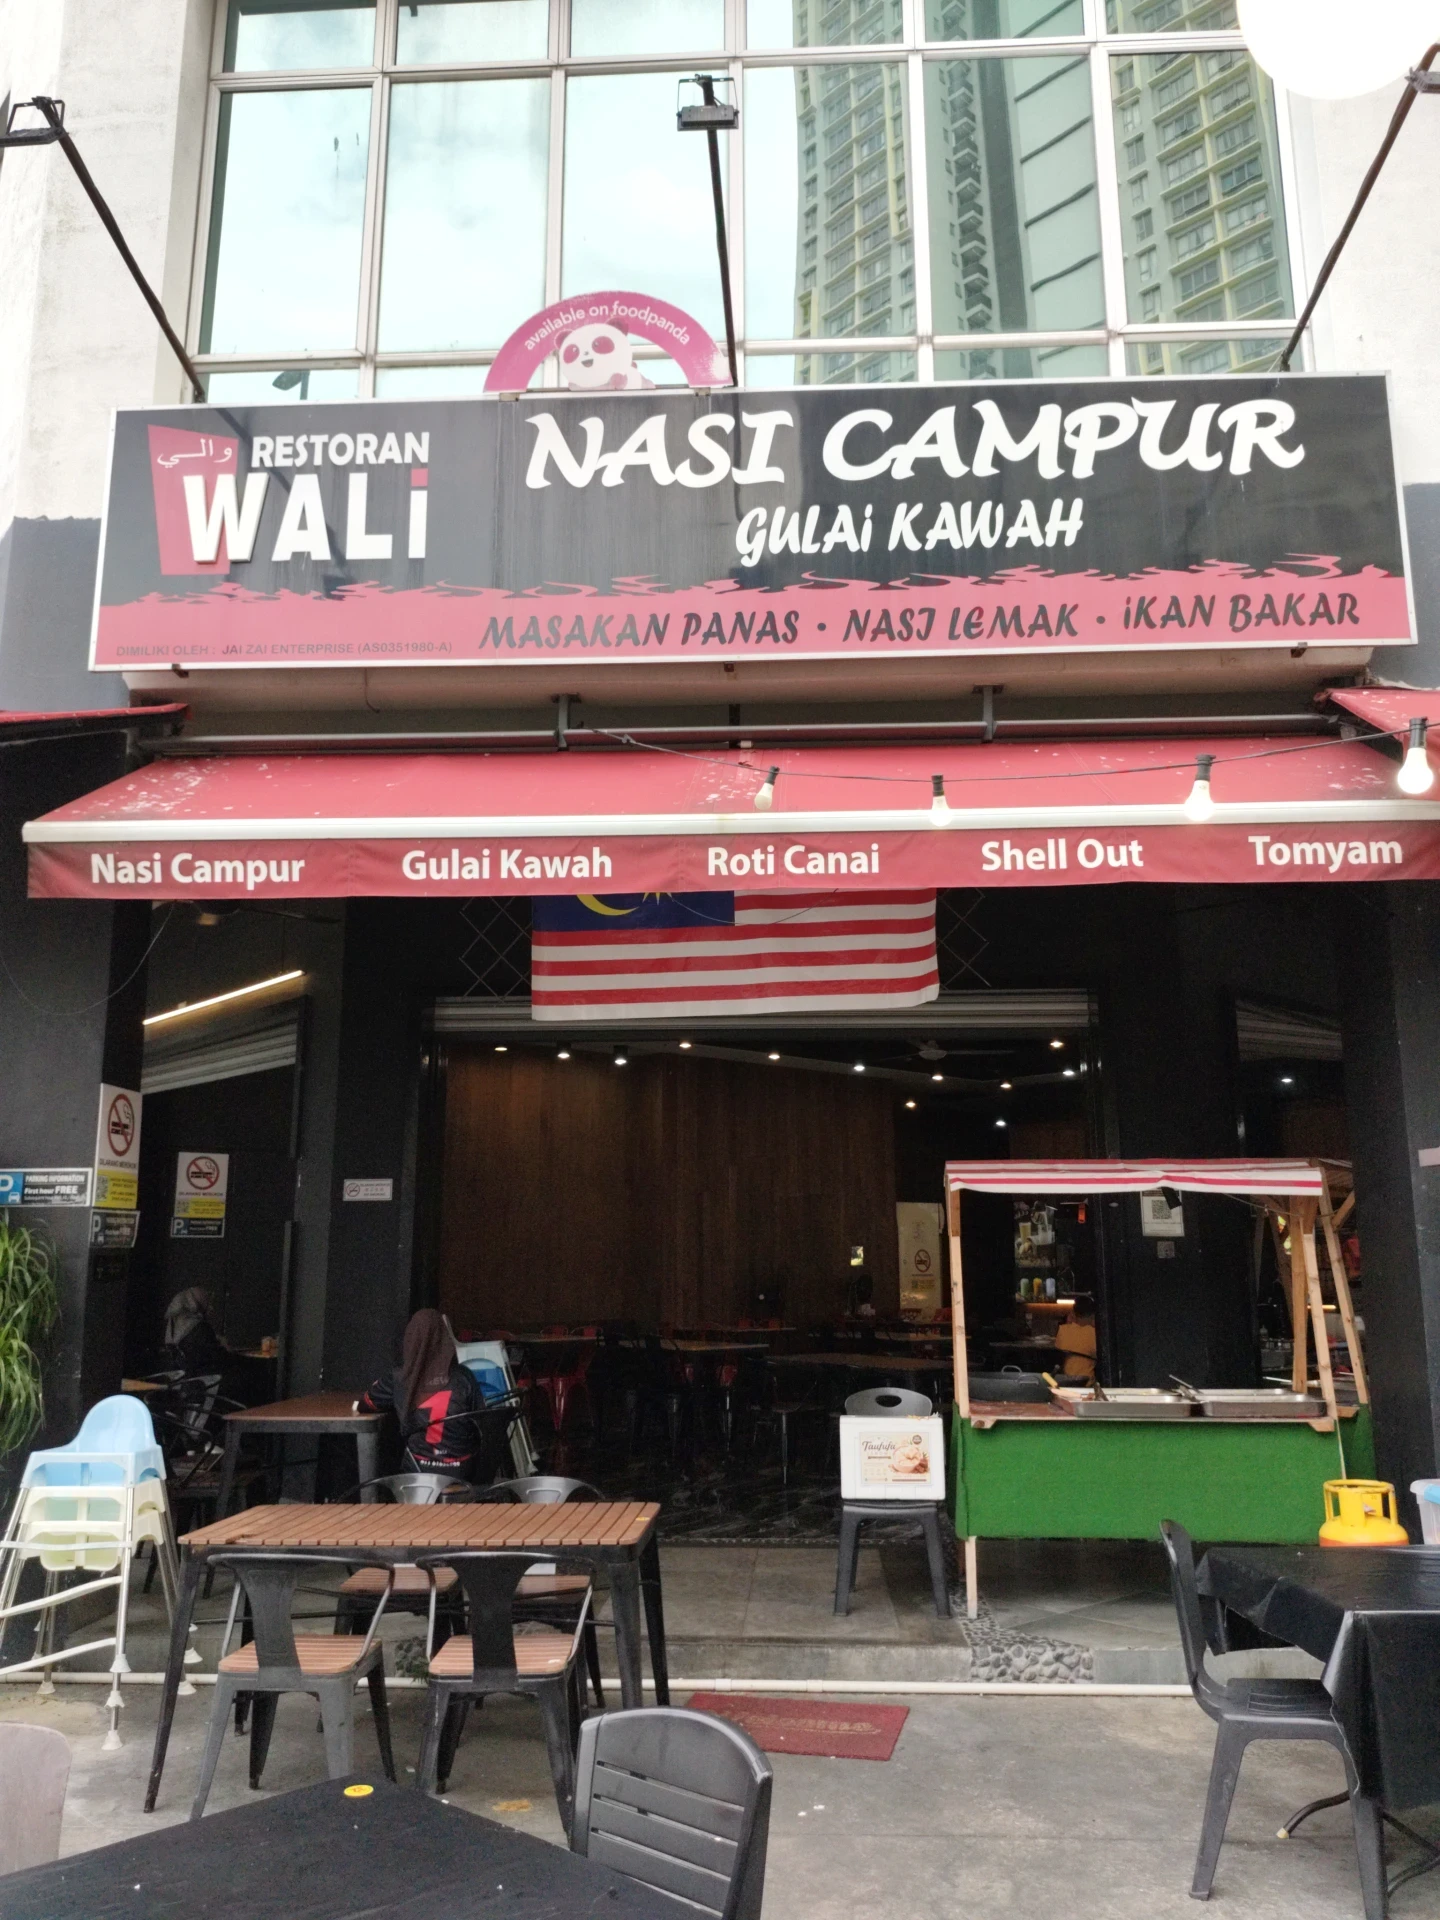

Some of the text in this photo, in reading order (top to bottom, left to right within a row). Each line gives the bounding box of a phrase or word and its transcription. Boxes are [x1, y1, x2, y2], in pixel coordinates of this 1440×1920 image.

[524, 300, 690, 350] available on foodpanda
[251, 431, 431, 468] RESTORAN
[523, 397, 1306, 491] NASI CAMPUR
[887, 497, 1085, 553] KAWAH
[478, 613, 671, 650] MASAKAN
[680, 609, 800, 646] PANAS
[842, 606, 937, 643] NASI
[947, 602, 1080, 643] LEMAK
[1228, 591, 1361, 633] BAKAR
[116, 646, 169, 656] DIMILIKI
[222, 644, 242, 655] JAI
[245, 643, 267, 654] ZAI
[271, 643, 354, 655] ENTERPRISE
[357, 642, 453, 654] (AS0351980-A)
[89, 850, 306, 891] Nasi Campur
[402, 846, 613, 881] Gulai Kawah
[707, 842, 881, 876] Roti Canai
[981, 837, 1144, 872] Shell Out
[1247, 834, 1404, 874] Tomyam
[49, 1174, 85, 1182] INFORMATION
[55, 1185, 78, 1194] FREE
[861, 1440, 896, 1451] Taufufa
